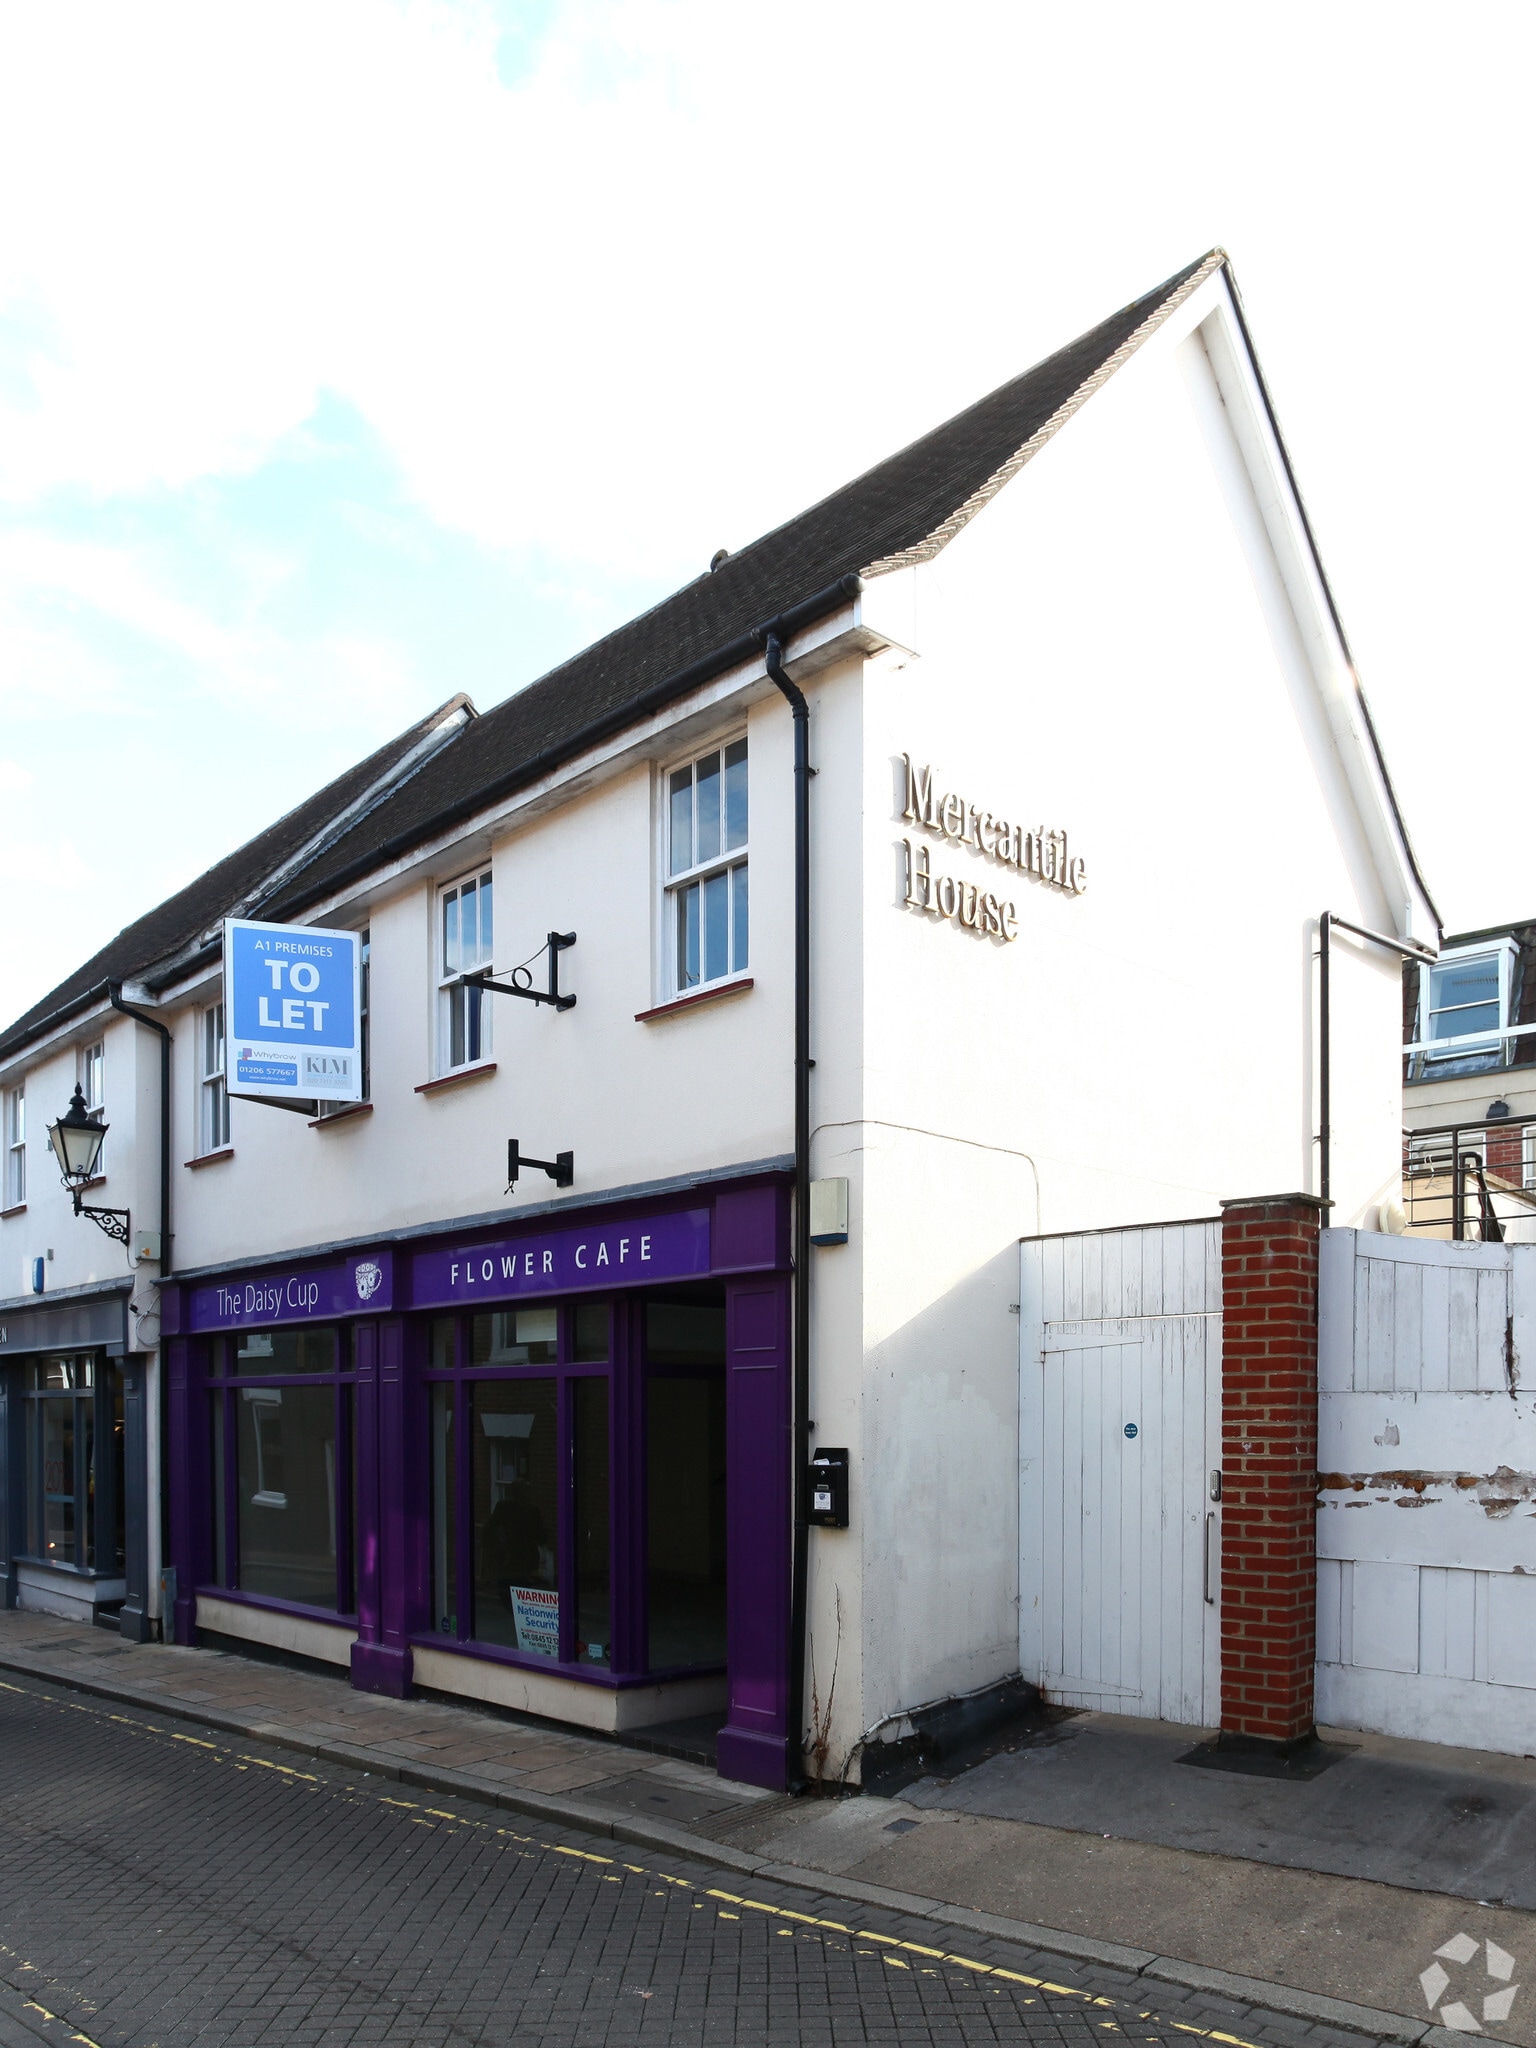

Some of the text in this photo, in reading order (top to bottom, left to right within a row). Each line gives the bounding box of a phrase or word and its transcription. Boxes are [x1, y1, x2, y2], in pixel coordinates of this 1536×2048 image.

[902, 752, 1087, 895] Mercantile
[902, 838, 1018, 942] House
[254, 940, 333, 957] A1 PREMISES
[264, 959, 320, 993] TO
[258, 996, 330, 1031] LET
[253, 1051, 297, 1060] Whybrow
[307, 1057, 347, 1075] KLM
[239, 1066, 296, 1076] 01206 577667
[451, 1235, 651, 1285] FLOWER CAFE
[216, 1277, 319, 1317] The Daisy Cup
[516, 1589, 558, 1605] WARNIN
[517, 1605, 560, 1621] Nationwi
